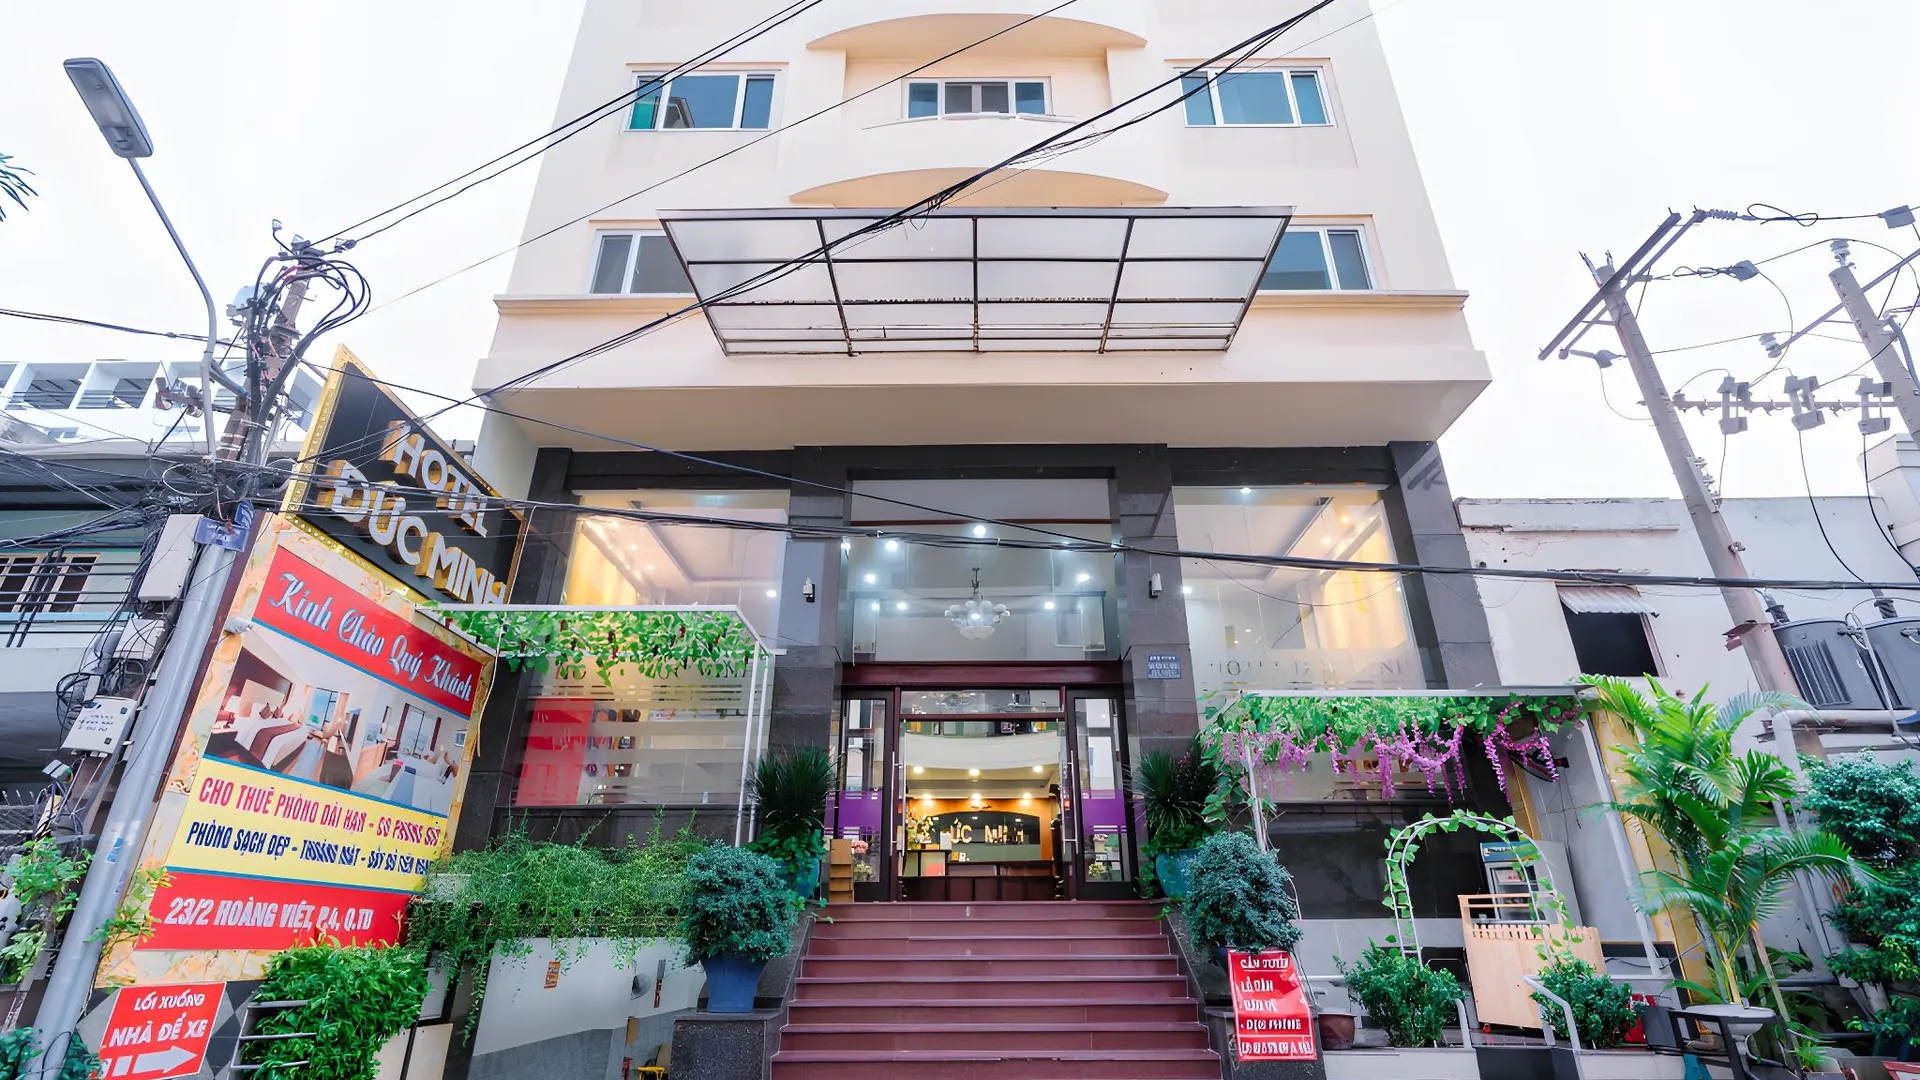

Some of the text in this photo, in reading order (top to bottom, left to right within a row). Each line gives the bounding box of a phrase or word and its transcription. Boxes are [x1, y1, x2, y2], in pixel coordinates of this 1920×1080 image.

[381, 420, 488, 538] HOTEL
[415, 532, 507, 604] MINH
[198, 777, 234, 807] CHO
[236, 784, 275, 815] THUÊ
[233, 828, 268, 856] SẠCH
[164, 897, 215, 926] 23/2
[213, 896, 279, 928] HOÀNG
[134, 991, 157, 1011] LỐI
[109, 1020, 154, 1048] NHÀ
[183, 1019, 209, 1040] XE
